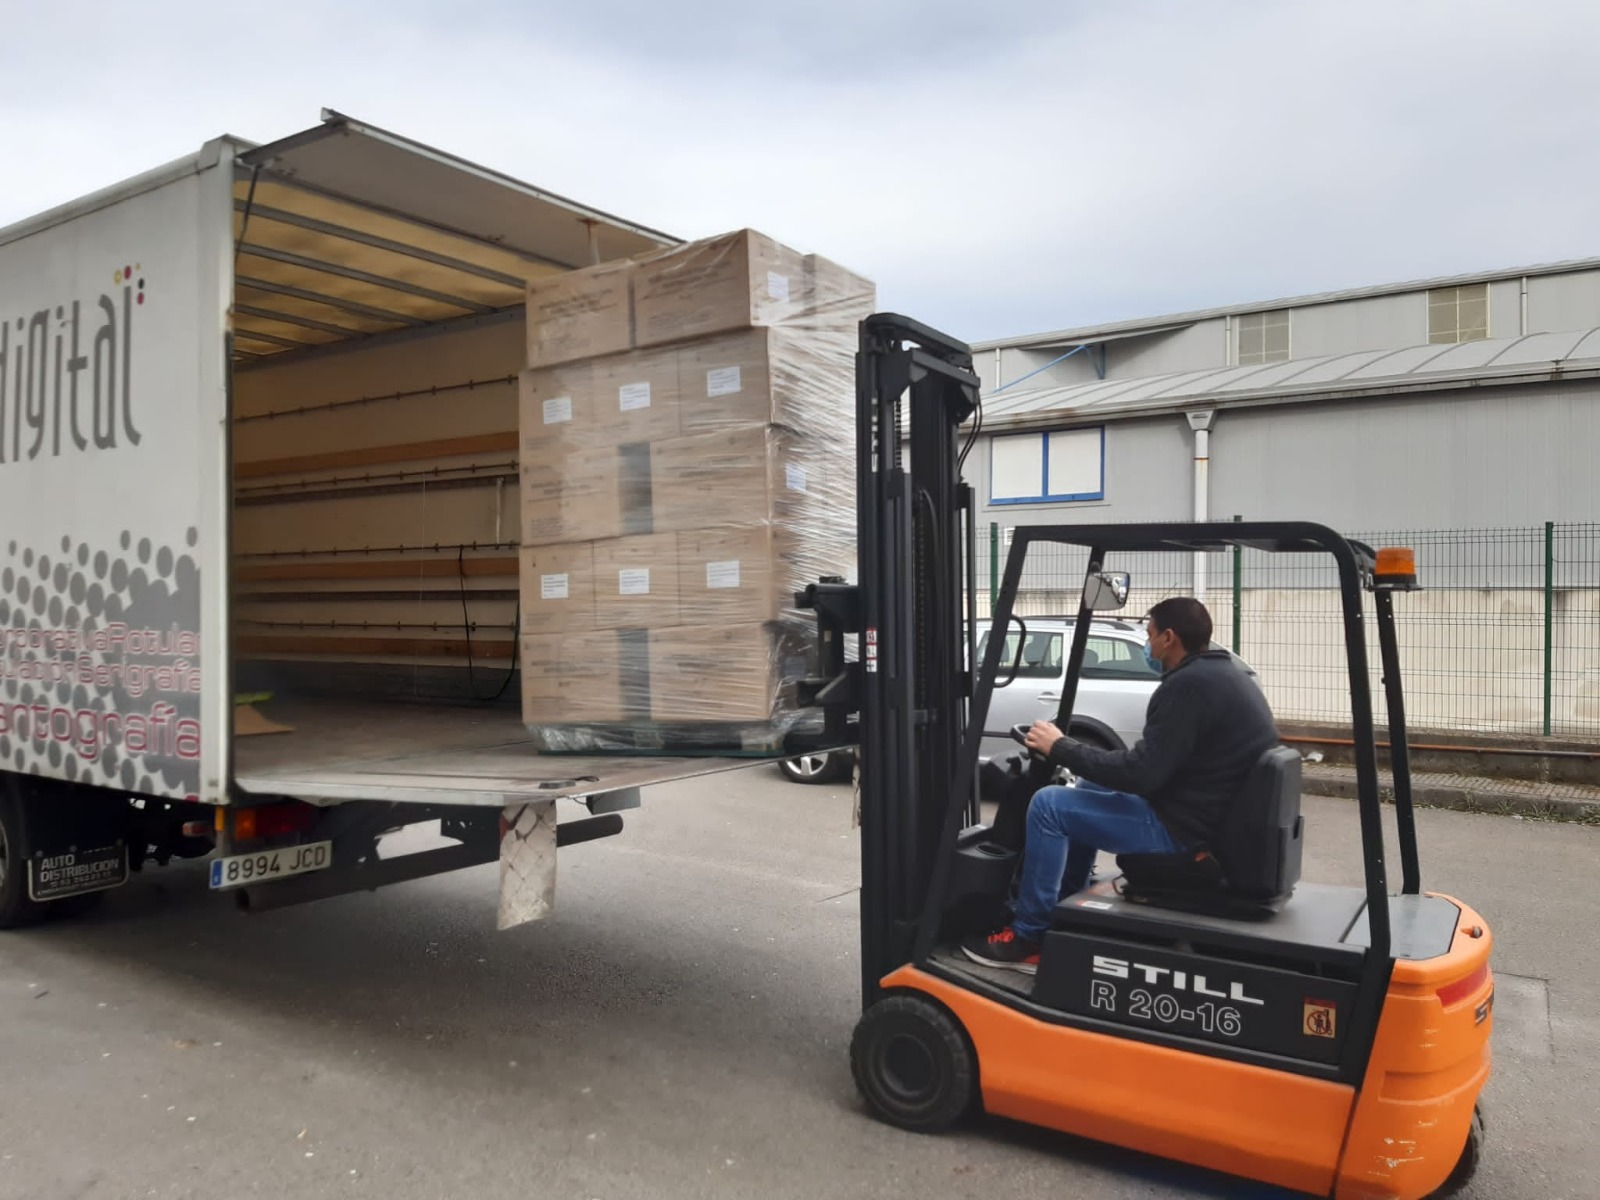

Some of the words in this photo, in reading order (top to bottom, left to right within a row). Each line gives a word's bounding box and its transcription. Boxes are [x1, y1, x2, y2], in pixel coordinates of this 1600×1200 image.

[41, 853, 75, 871] AUTO
[226, 852, 280, 882] 8994
[289, 845, 326, 871] JCD
[1093, 955, 1264, 1006] STILL
[1091, 979, 1117, 1012] R
[1129, 988, 1241, 1037] 20-16
